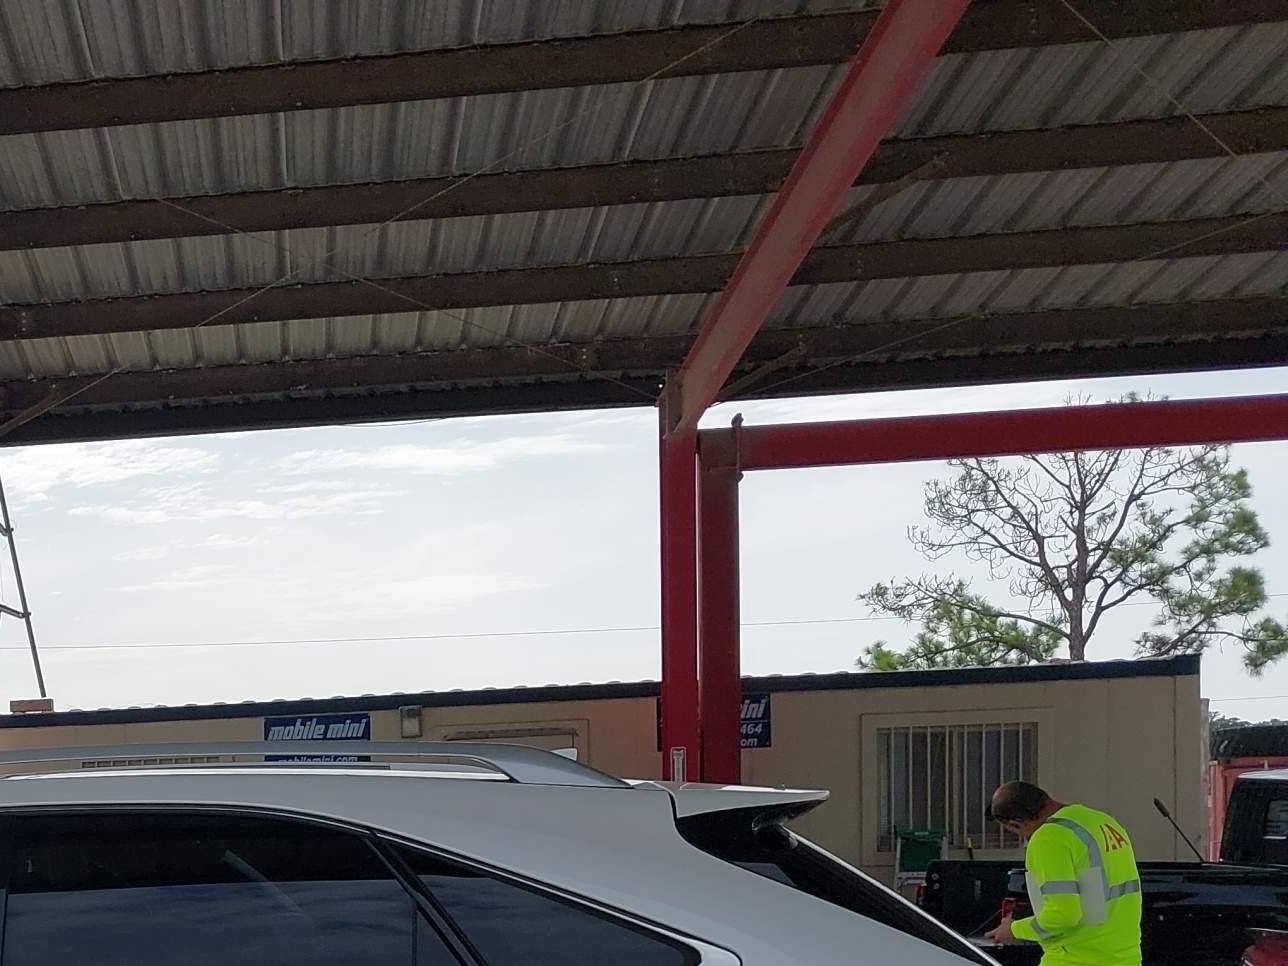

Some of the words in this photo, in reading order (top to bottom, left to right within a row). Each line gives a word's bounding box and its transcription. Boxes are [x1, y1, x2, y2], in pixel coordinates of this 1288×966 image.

[739, 699, 767, 719] ini
[267, 718, 325, 741] mobile
[326, 719, 367, 739] mini
